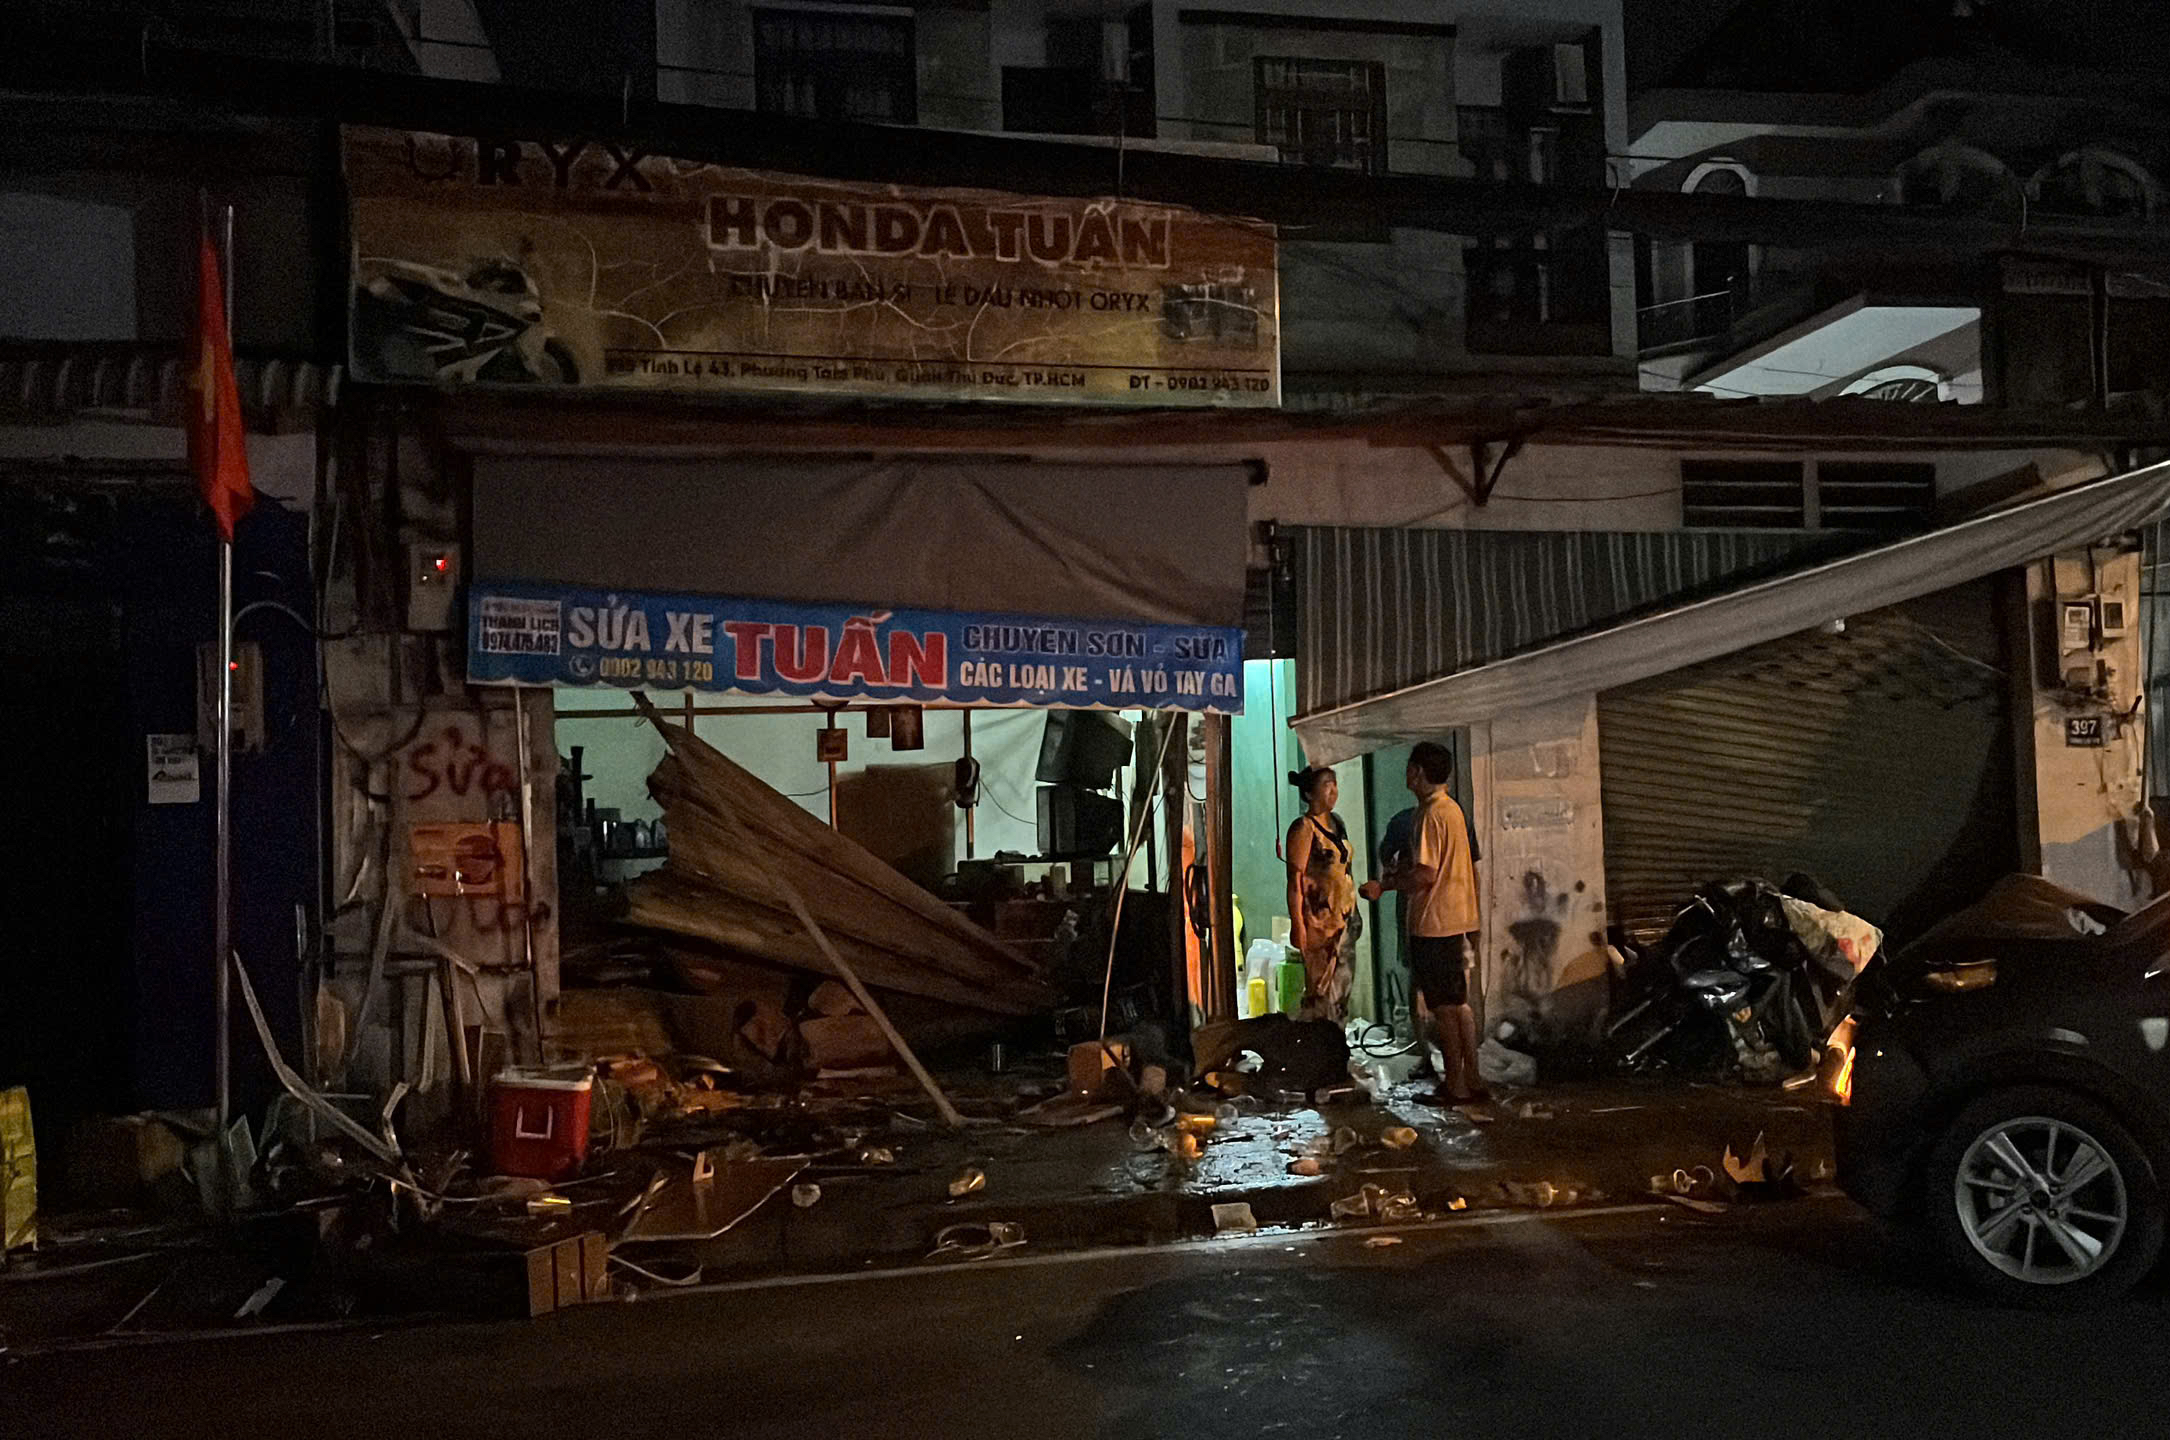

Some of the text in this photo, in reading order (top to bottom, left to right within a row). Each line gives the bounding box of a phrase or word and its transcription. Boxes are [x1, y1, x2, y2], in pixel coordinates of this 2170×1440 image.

[706, 197, 974, 258] HONDA
[1090, 291, 1150, 312] ORYX
[1022, 371, 1086, 387] TP.HCM
[1167, 376, 1207, 391] 0902
[1244, 377, 1270, 392] 120
[568, 594, 715, 654] SỬA XE
[961, 622, 1080, 656] CHUYÊN
[1086, 629, 1146, 660] SƠN
[724, 610, 948, 690] TUẤN
[682, 657, 714, 682] 120
[960, 657, 1003, 688] CÁC
[1009, 663, 1056, 696] LOẠI
[1061, 666, 1089, 692] XE
[1108, 664, 1136, 694] VÁ
[1140, 662, 1168, 694] VỎ
[1173, 670, 1206, 695] TAY
[1209, 671, 1238, 698] GA
[2071, 719, 2097, 736] 397
